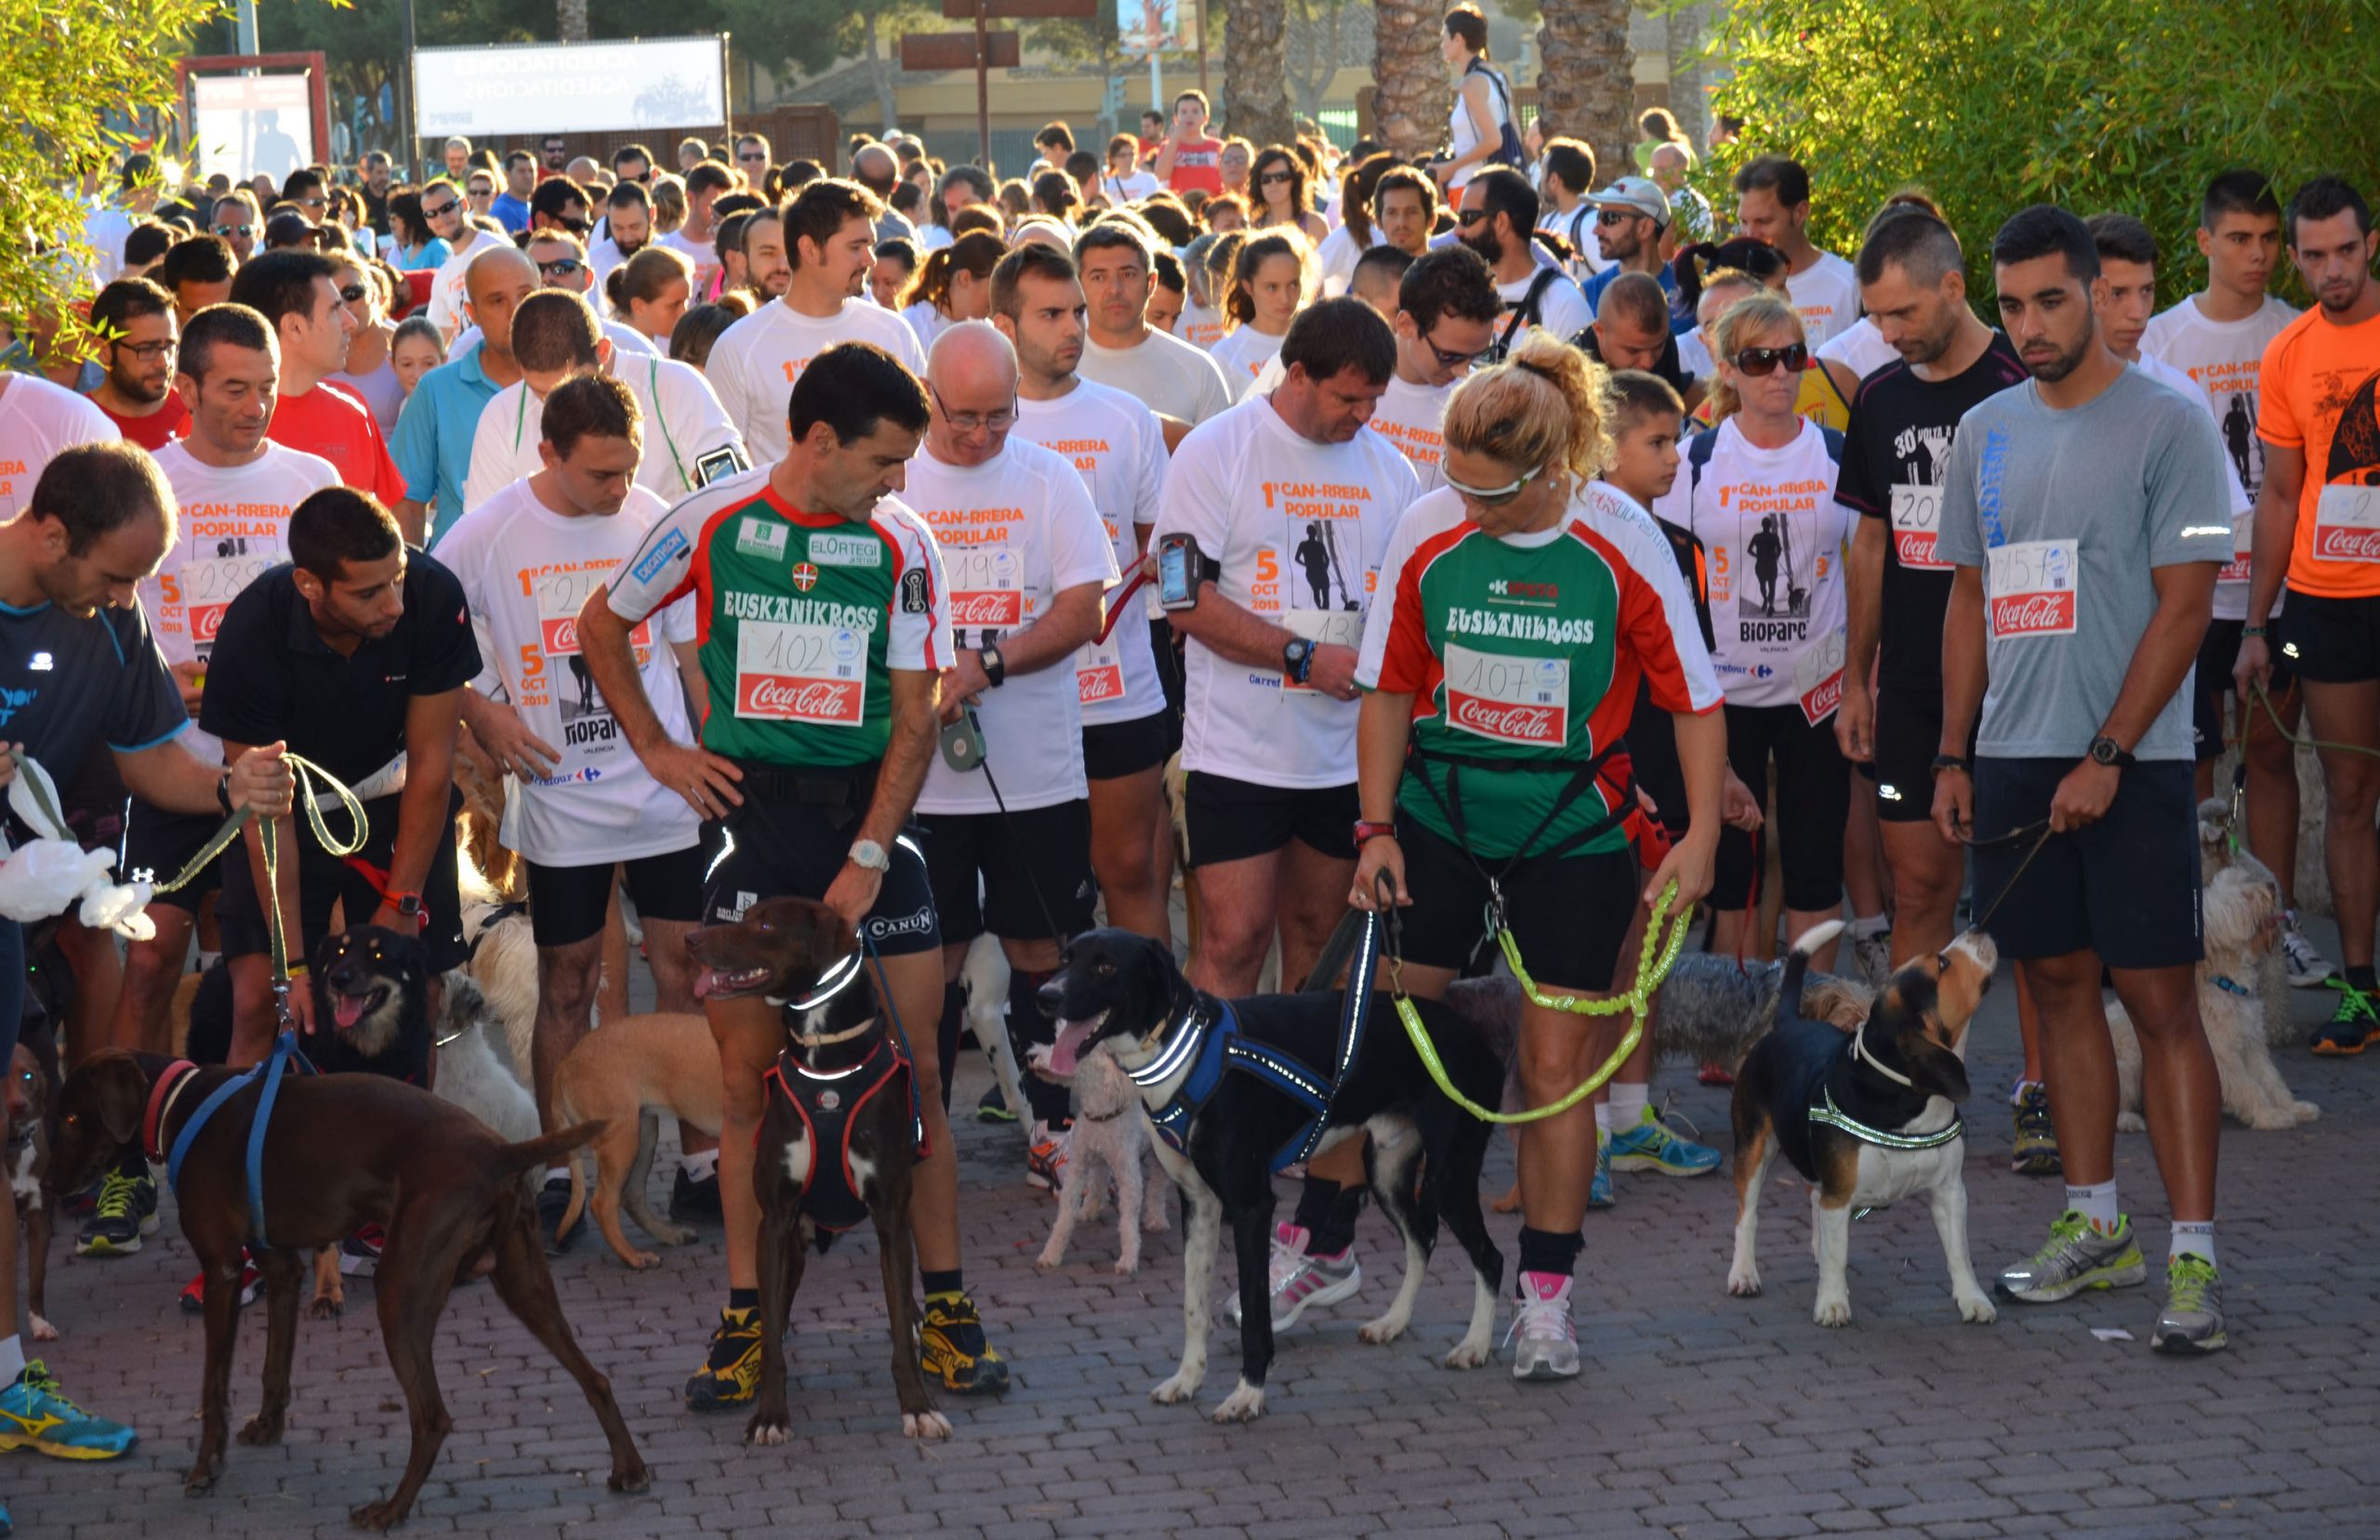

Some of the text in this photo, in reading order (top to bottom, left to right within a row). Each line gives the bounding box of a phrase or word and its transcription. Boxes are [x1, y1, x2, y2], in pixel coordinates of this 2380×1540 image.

[2206, 360, 2261, 377] CAN-RR
[2209, 380, 2259, 394] POPUL
[1369, 417, 1444, 446] CAN-RRE
[1281, 481, 1372, 502] CAN-RRERA
[1739, 480, 1829, 497] CAN-RRERA
[190, 503, 292, 519] CAN-RRERA
[1284, 501, 1361, 520] POPULAR
[1739, 496, 1816, 513] POPULAR
[926, 507, 1026, 525] CAN-RRERA
[192, 521, 278, 537] POPULAR
[932, 526, 1009, 545] POPULAR
[637, 532, 682, 580] DECATHLON
[1712, 546, 1729, 574] 5
[1255, 550, 1279, 582] 5
[159, 573, 181, 604] 5
[1250, 583, 1280, 596] OCT
[159, 606, 183, 618] OCT
[1250, 599, 1280, 612] 2013
[160, 621, 183, 634] 2013
[766, 629, 826, 672] 102
[520, 643, 544, 677] 5
[1713, 664, 1748, 675] rrefour
[520, 678, 548, 691] OCT
[1249, 673, 1281, 688] Carref
[1463, 658, 1529, 699] 107
[522, 694, 549, 706] 2013
[871, 911, 931, 937] CANUN
